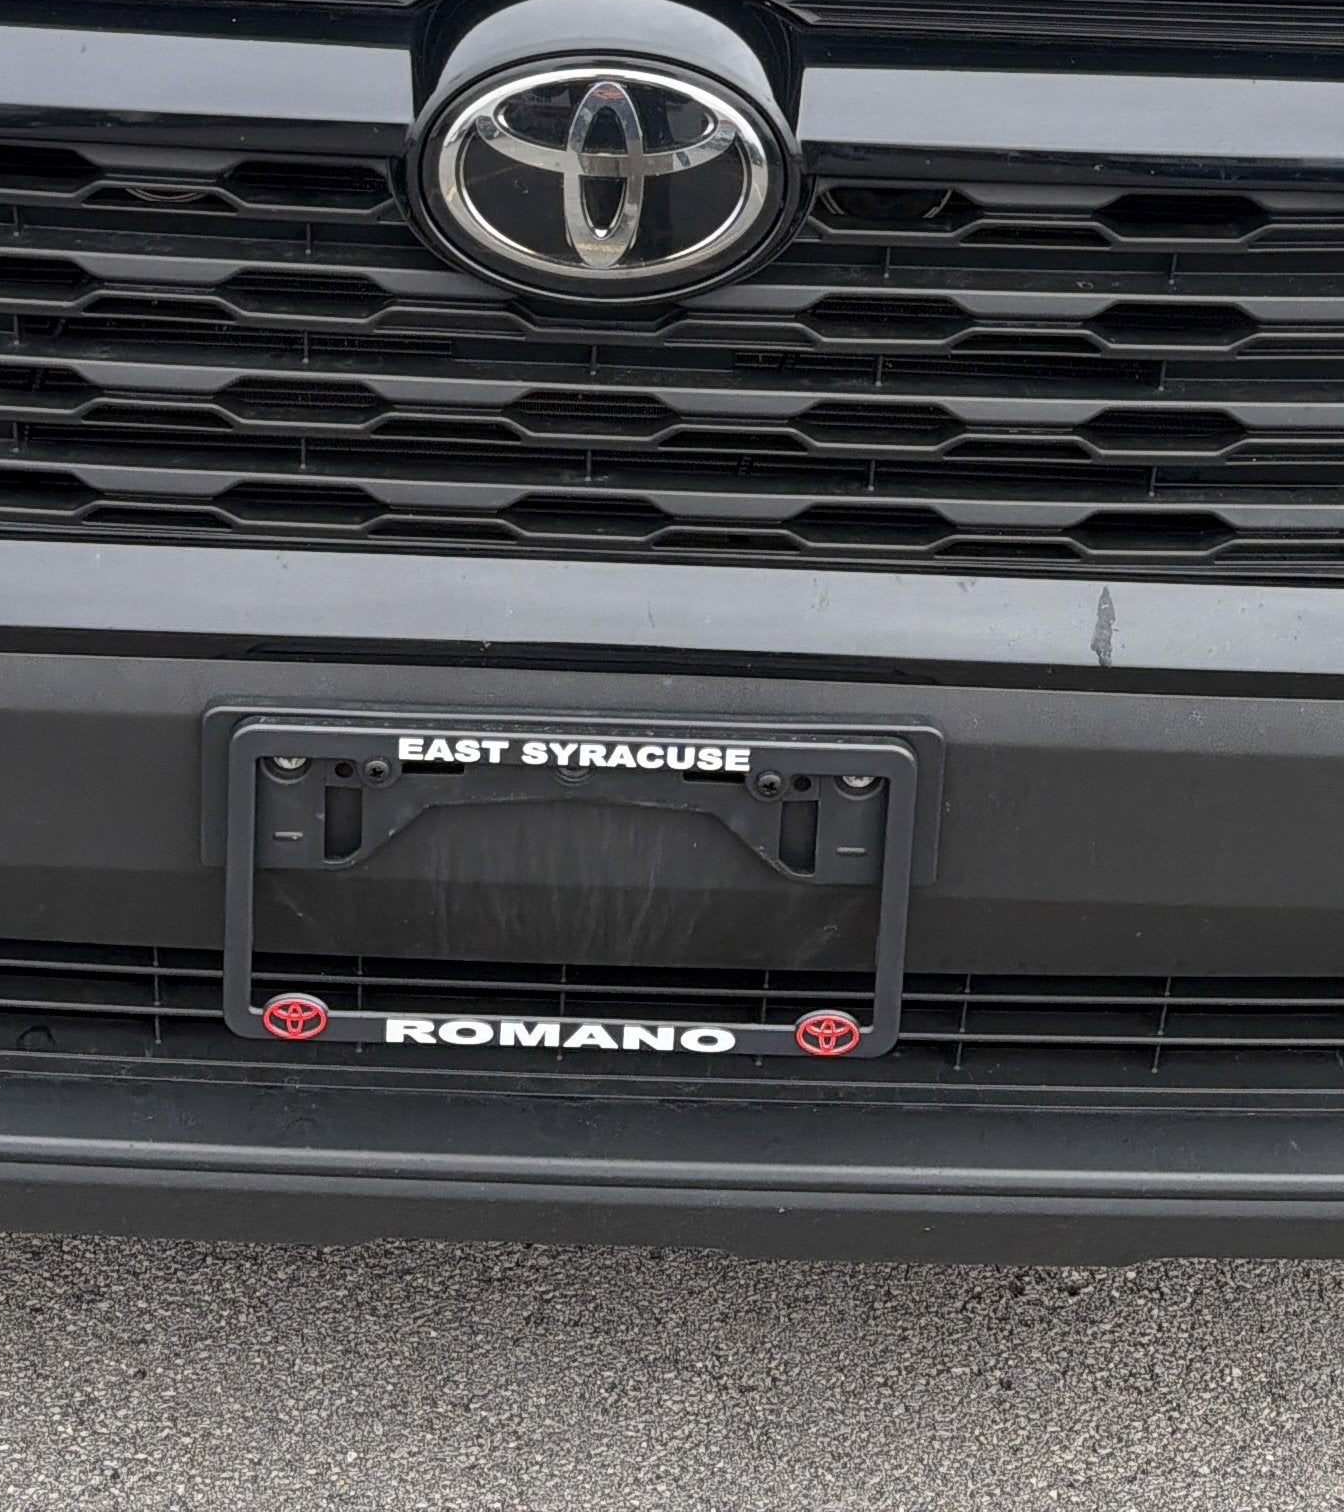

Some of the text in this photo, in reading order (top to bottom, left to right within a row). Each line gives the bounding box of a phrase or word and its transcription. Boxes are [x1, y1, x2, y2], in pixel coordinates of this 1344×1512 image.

[398, 737, 751, 771] EAST SYRACUSE
[385, 1018, 736, 1053] ROMANO
